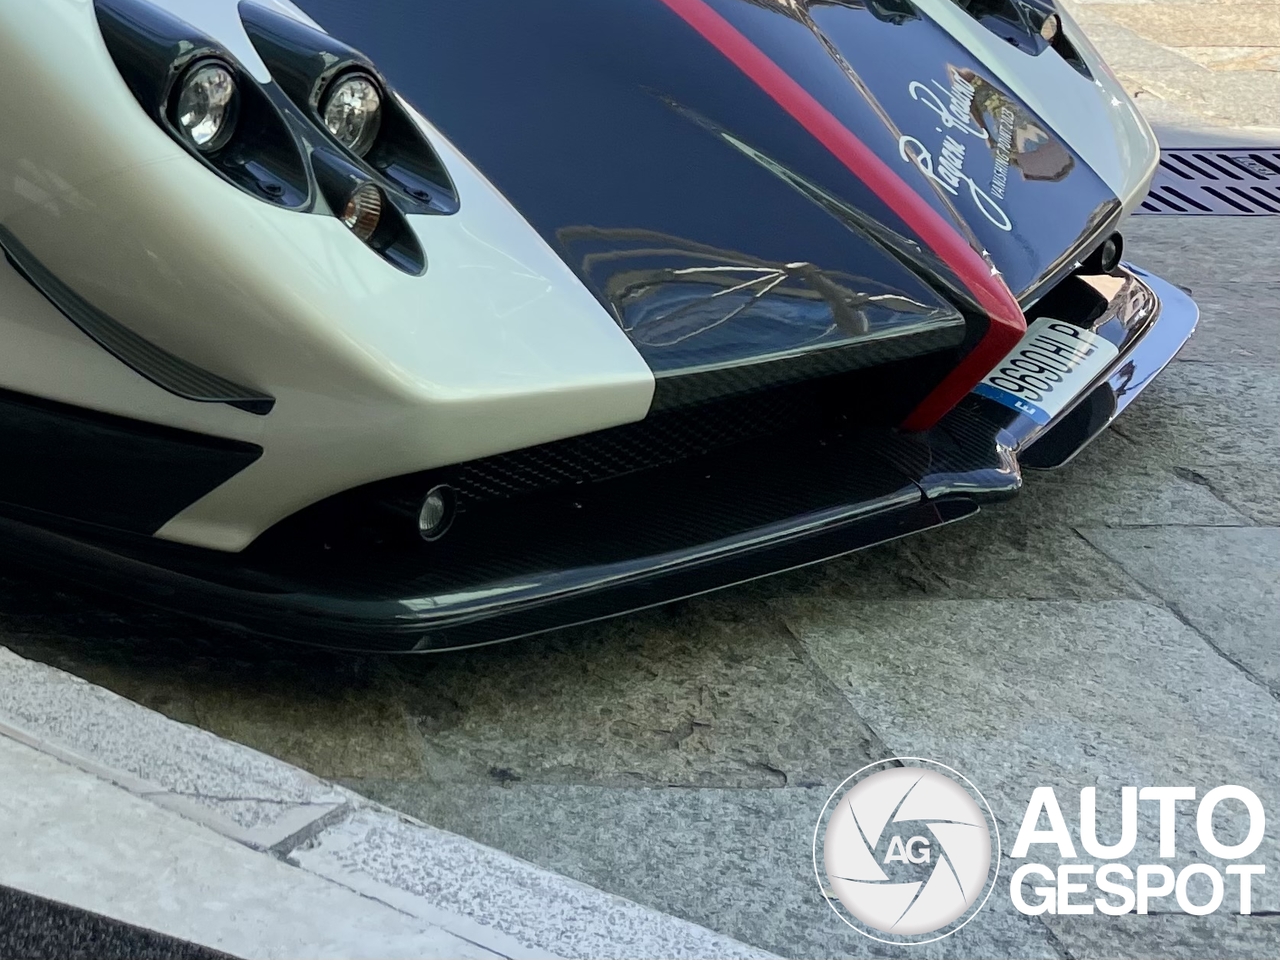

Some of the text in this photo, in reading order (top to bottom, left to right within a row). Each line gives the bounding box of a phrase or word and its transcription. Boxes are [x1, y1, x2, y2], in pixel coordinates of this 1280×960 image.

[898, 70, 1013, 232] Pagani Raduno
[991, 149, 1010, 200] VANISHING
[1014, 400, 1036, 415] E
